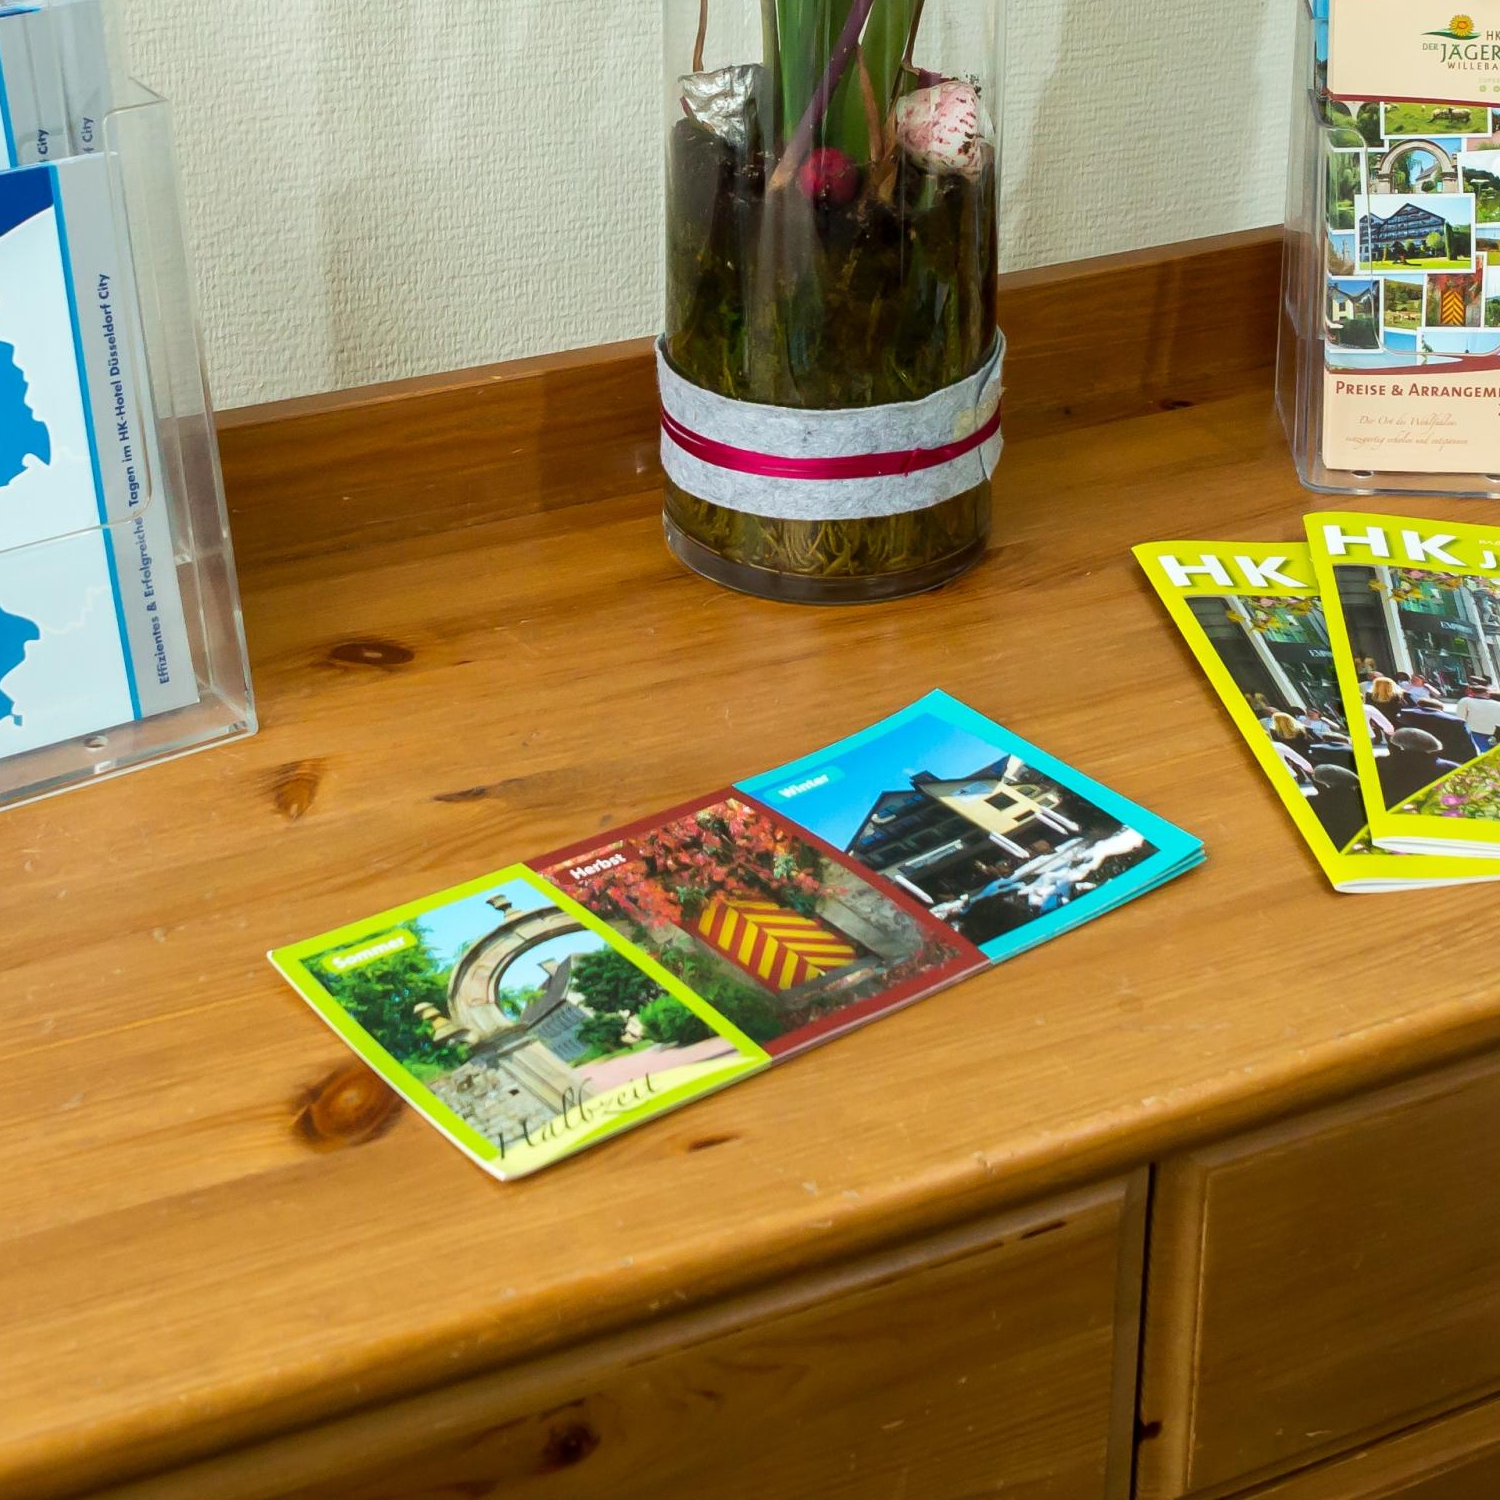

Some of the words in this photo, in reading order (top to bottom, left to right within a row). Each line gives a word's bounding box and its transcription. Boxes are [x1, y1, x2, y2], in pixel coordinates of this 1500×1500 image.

[37, 129, 49, 155] City
[81, 117, 94, 143] City
[97, 274, 110, 300] City
[99, 304, 121, 377] Düsseldorf
[1336, 380, 1386, 396] PREISE
[1391, 384, 1403, 396] &
[110, 379, 129, 442] HK-Hotel
[122, 444, 133, 463] im
[126, 466, 140, 508] Tagen
[133, 511, 155, 598] Erfolgreiche
[1322, 524, 1468, 567] HK
[1158, 554, 1309, 588] HK
[147, 601, 157, 612] &
[151, 615, 170, 685] Effizientes
[778, 773, 830, 798] Winter
[569, 853, 627, 880] Herbst
[332, 936, 405, 969] Sommer
[498, 1072, 656, 1160] Halbzeit
